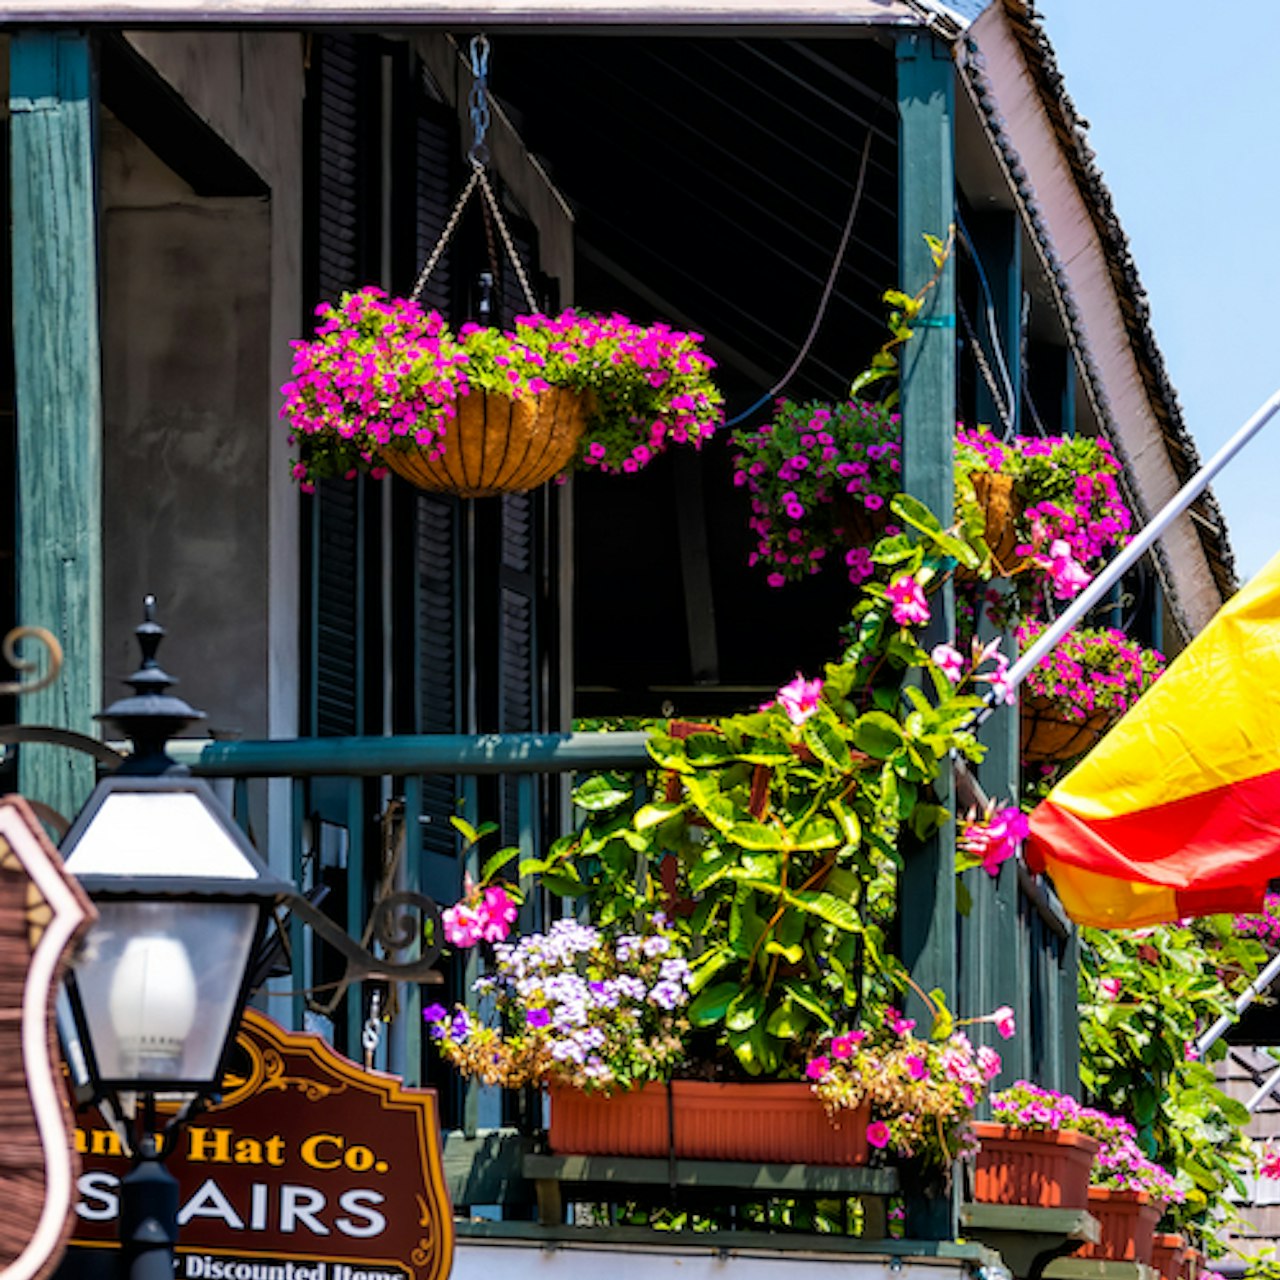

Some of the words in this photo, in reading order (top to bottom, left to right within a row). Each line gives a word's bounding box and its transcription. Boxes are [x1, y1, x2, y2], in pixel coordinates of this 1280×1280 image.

[187, 1126, 285, 1166] Hat
[301, 1134, 389, 1173] Co.
[75, 1172, 387, 1238] SAIRS
